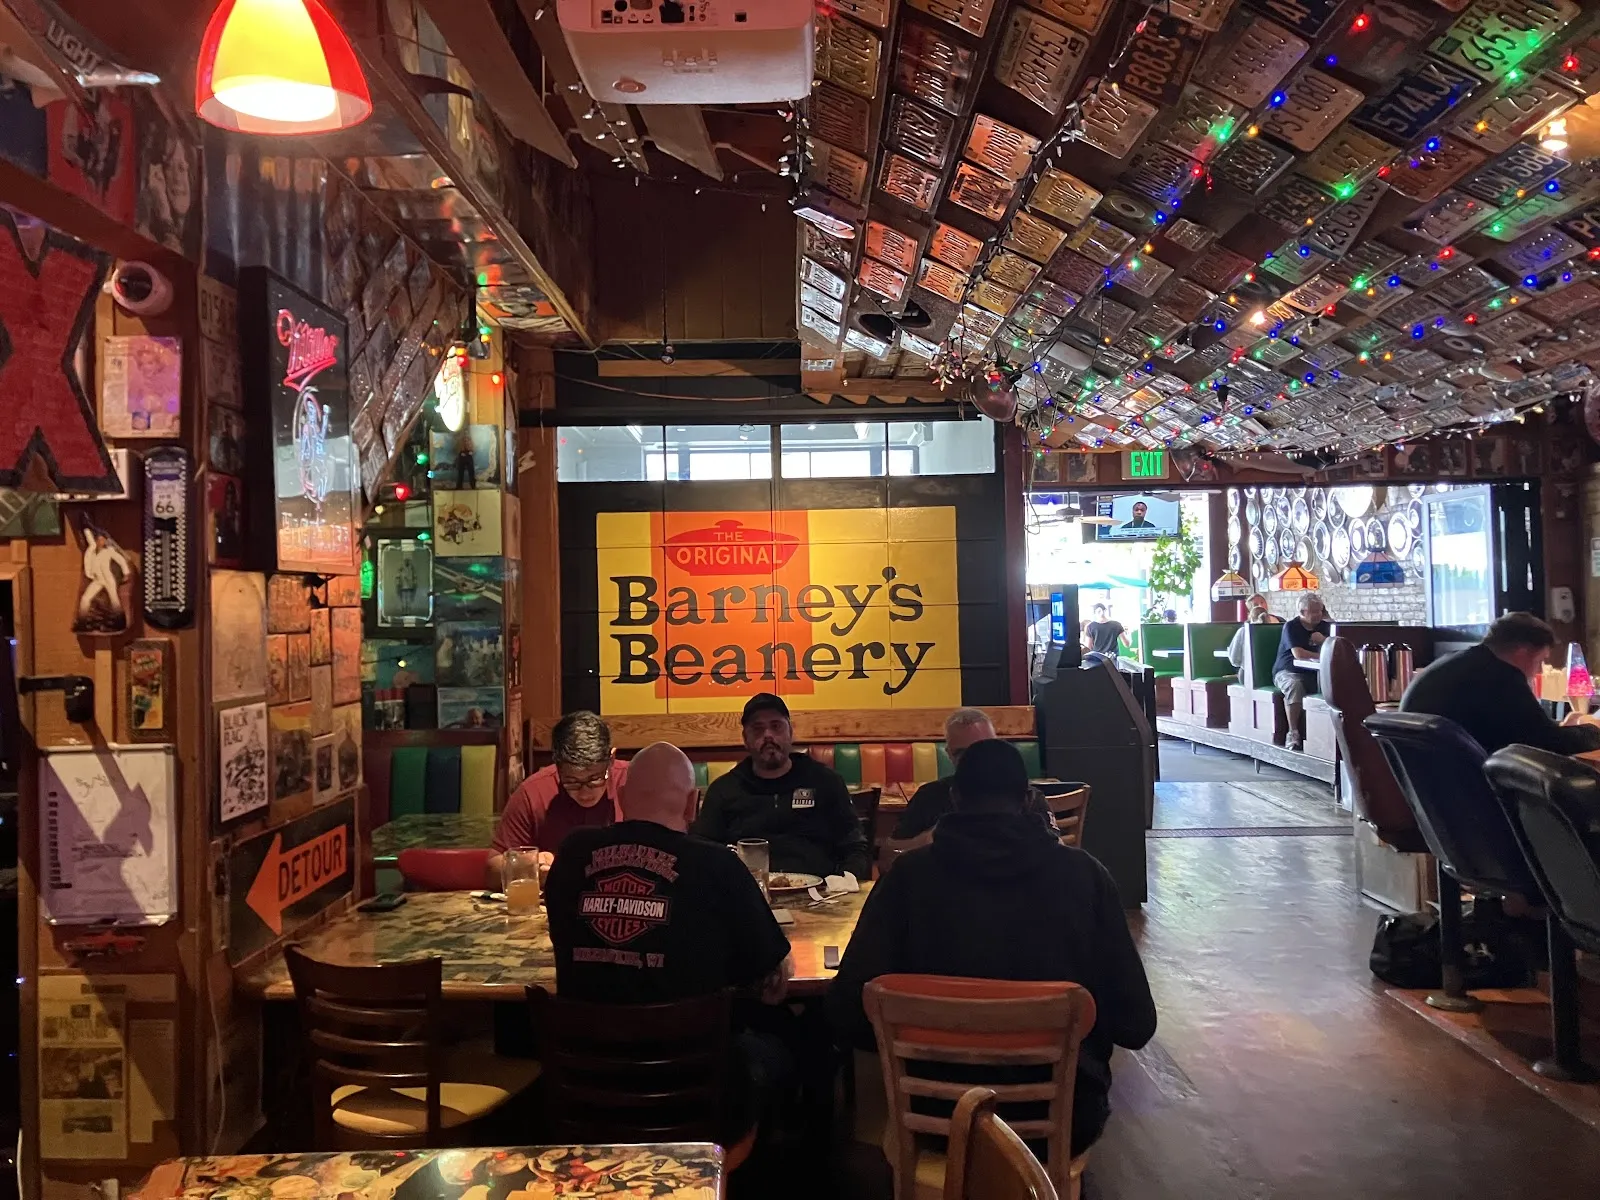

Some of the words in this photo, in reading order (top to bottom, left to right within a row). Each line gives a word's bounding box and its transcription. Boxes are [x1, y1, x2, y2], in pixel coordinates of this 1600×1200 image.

[1454, 0, 1502, 33] TEXAS
[46, 18, 104, 76] LIGHT
[1130, 451, 1163, 477] EXIT
[155, 501, 175, 514] 66
[713, 531, 744, 542] THE
[676, 545, 783, 566] ORIGINAL
[609, 566, 924, 637] Barney's
[610, 633, 936, 696] Beanery
[277, 834, 344, 903] DETOUR
[603, 879, 647, 895] MOTOR
[582, 897, 665, 918] HARLEY-DAVIDSON
[598, 918, 641, 939] CYCLES
